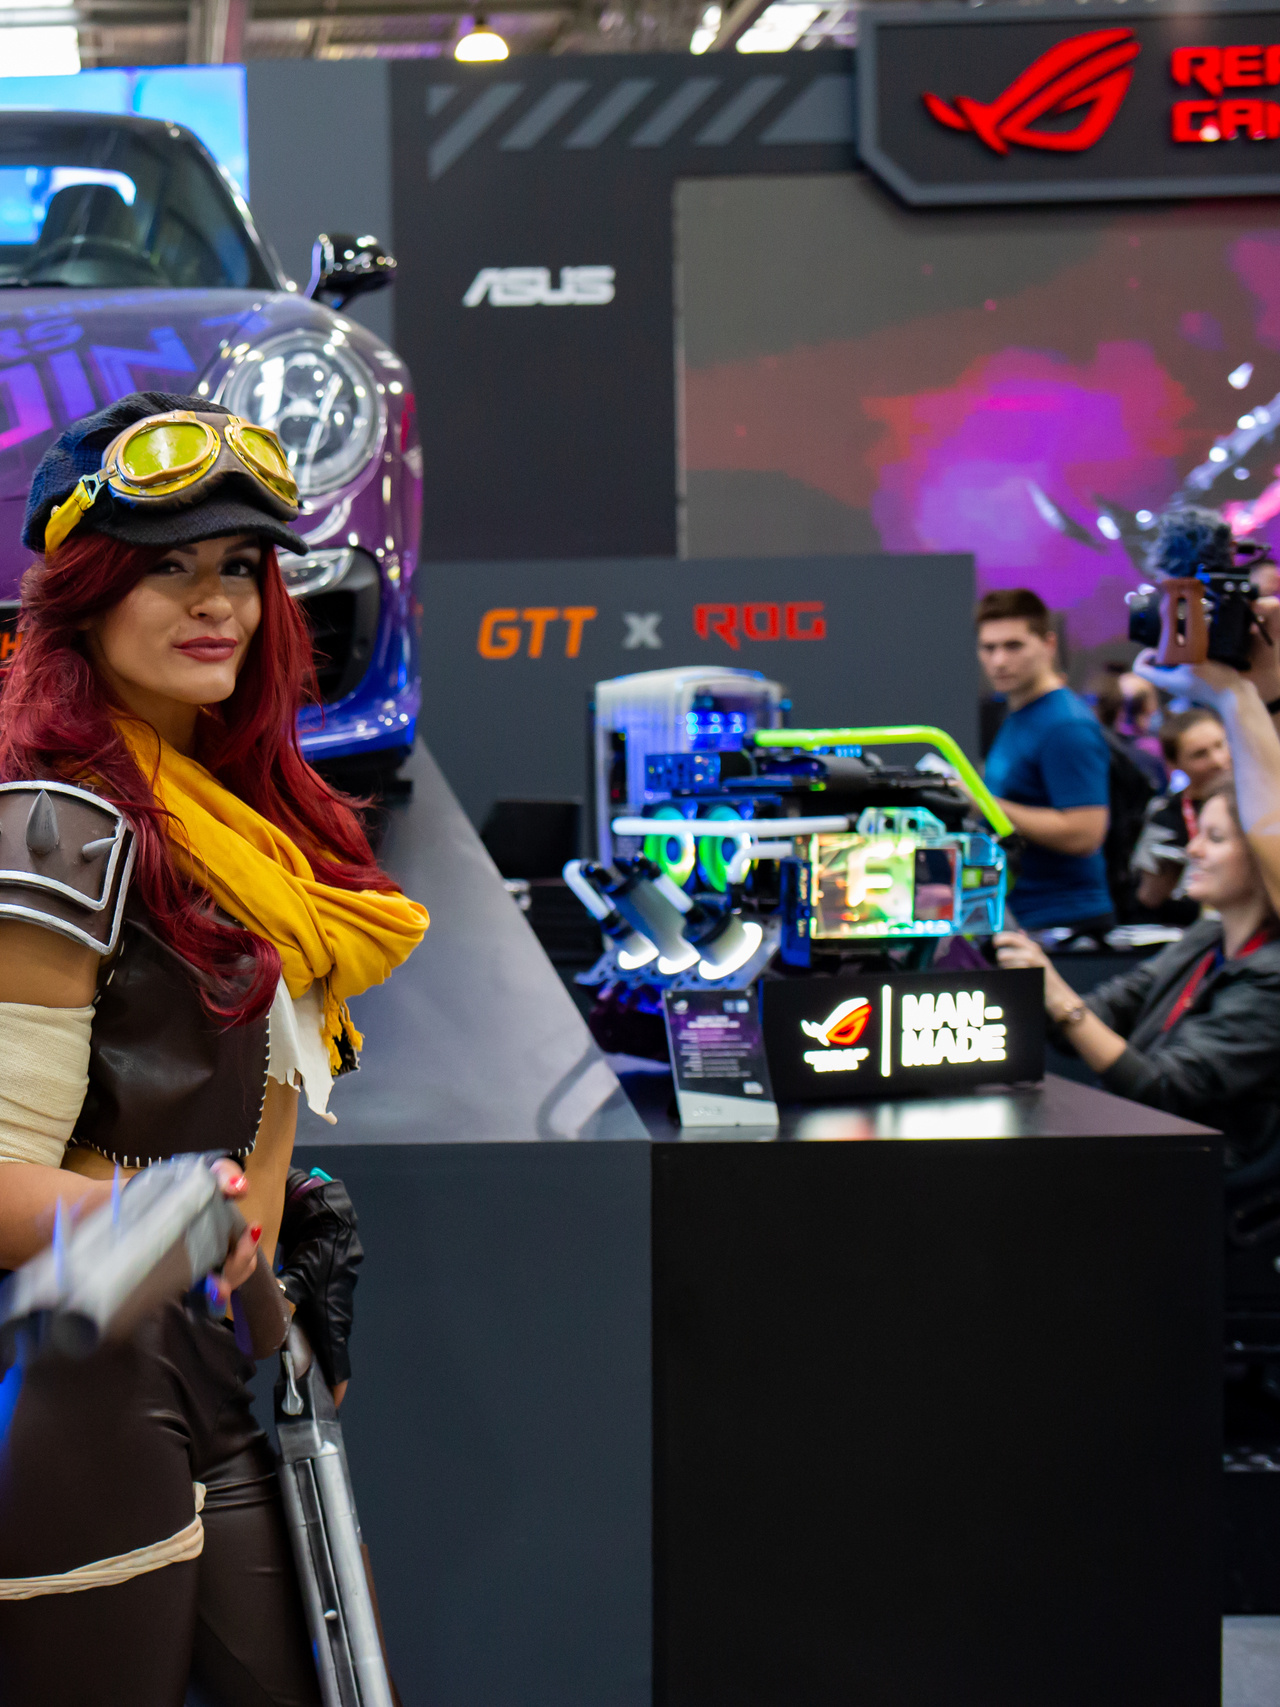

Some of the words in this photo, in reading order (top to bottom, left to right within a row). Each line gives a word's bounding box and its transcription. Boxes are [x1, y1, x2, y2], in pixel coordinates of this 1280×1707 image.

[463, 265, 615, 306] ASUS
[477, 606, 597, 659] GTT
[693, 601, 826, 650] ROG
[902, 990, 1003, 1031] MAN-
[901, 1024, 1007, 1067] MADE
